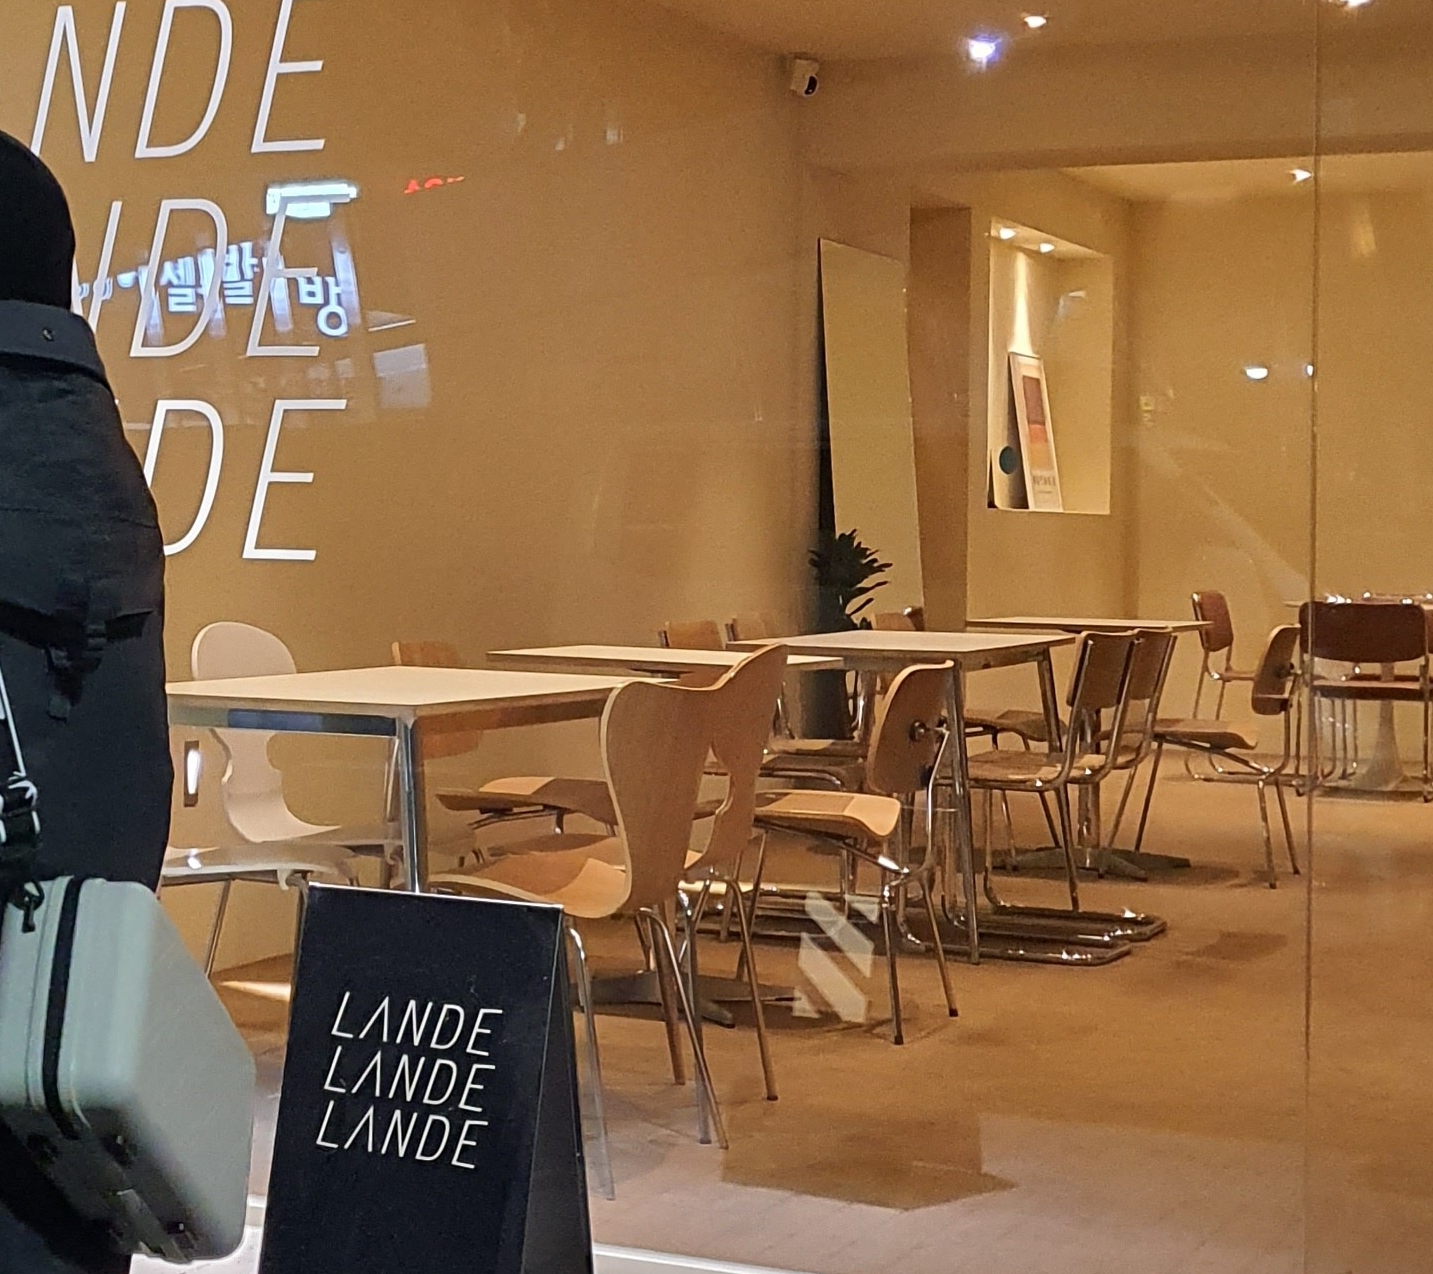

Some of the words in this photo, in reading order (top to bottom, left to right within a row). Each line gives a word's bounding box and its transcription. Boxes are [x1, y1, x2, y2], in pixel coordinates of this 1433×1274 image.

[330, 990, 504, 1057] LANDE
[323, 1044, 497, 1113] LANDE
[315, 1099, 490, 1169] LANDE
